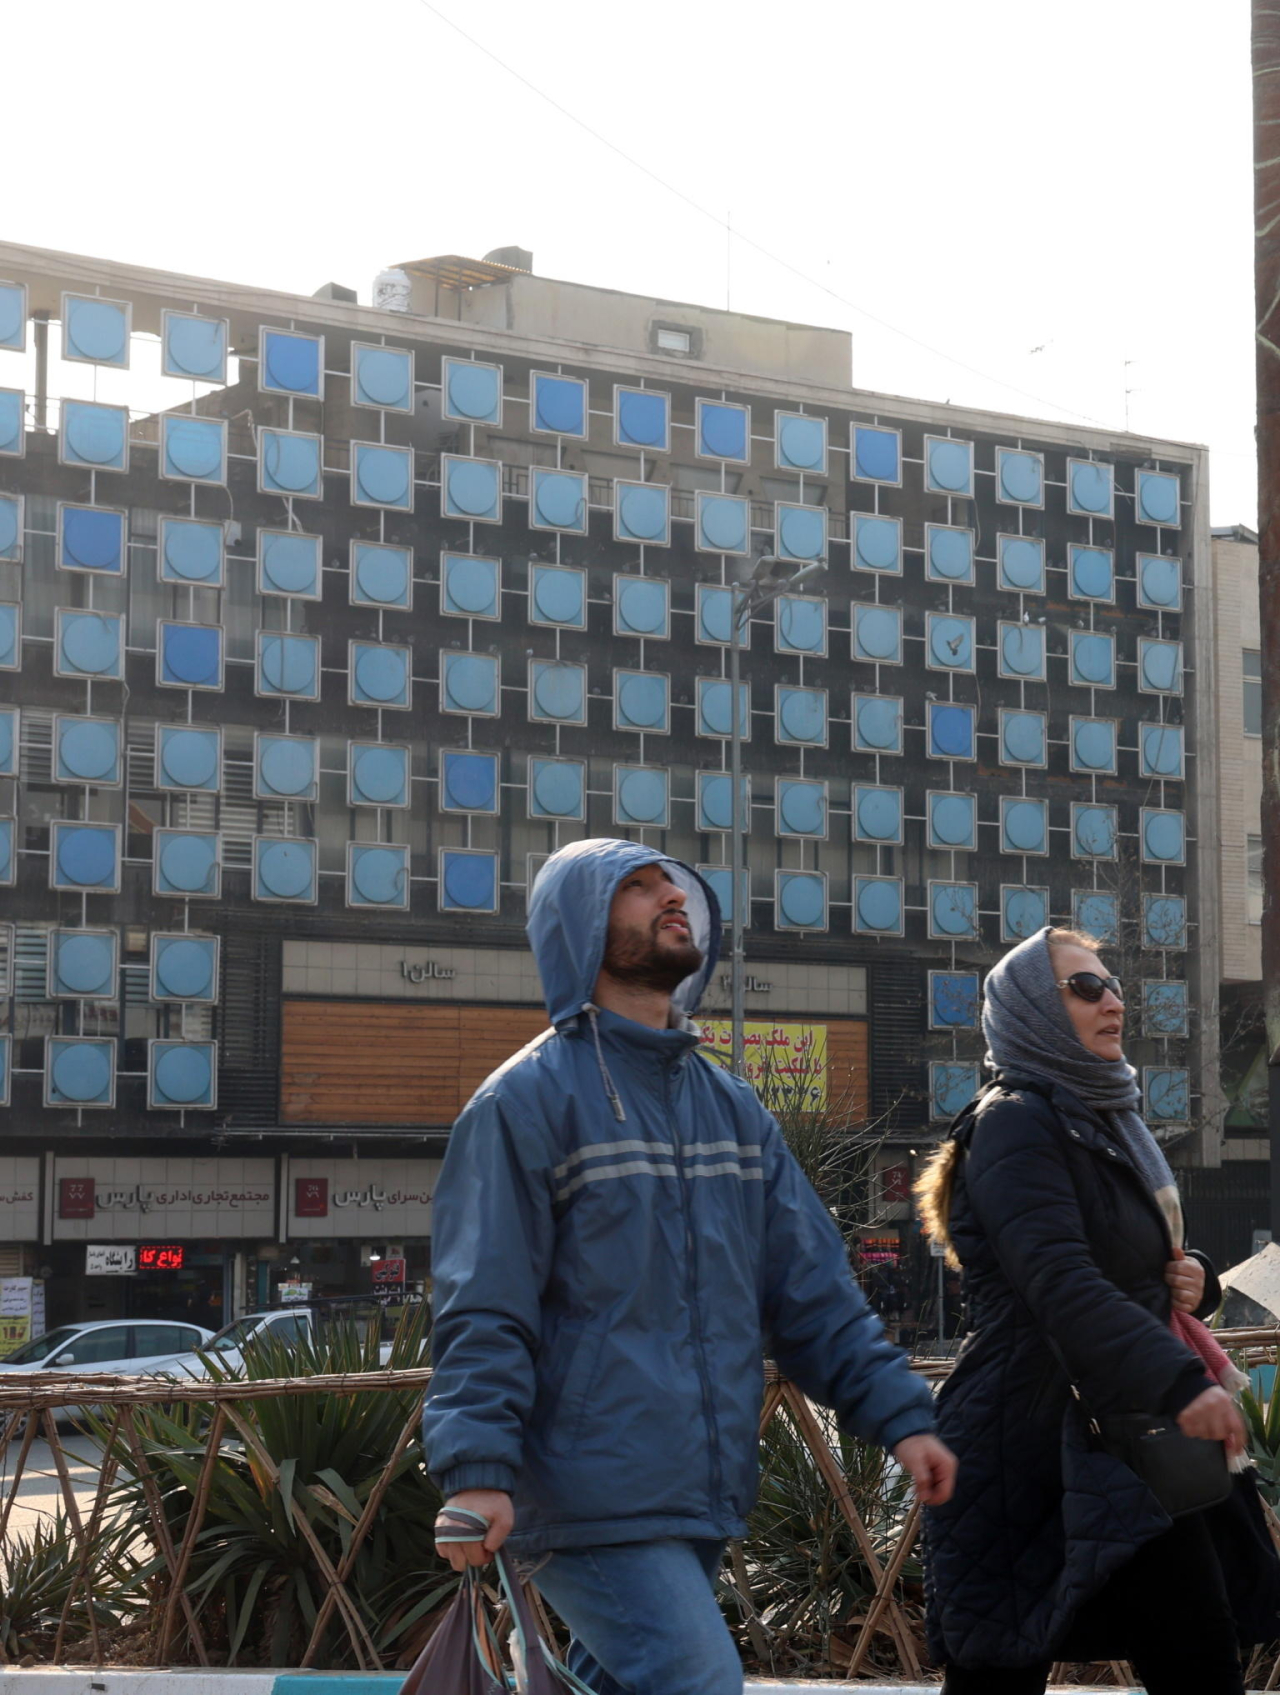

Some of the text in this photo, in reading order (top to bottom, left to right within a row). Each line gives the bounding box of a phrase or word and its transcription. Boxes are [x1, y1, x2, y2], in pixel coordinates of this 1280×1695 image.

[409, 960, 456, 983] سالن
[742, 975, 773, 993] سال
[765, 1028, 790, 1047] ملک
[69, 1184, 84, 1192] 77
[333, 1184, 387, 1211] پارس
[387, 1190, 419, 1205] سرای
[95, 1184, 270, 1213] مجتمع تجاری اداری پارس
